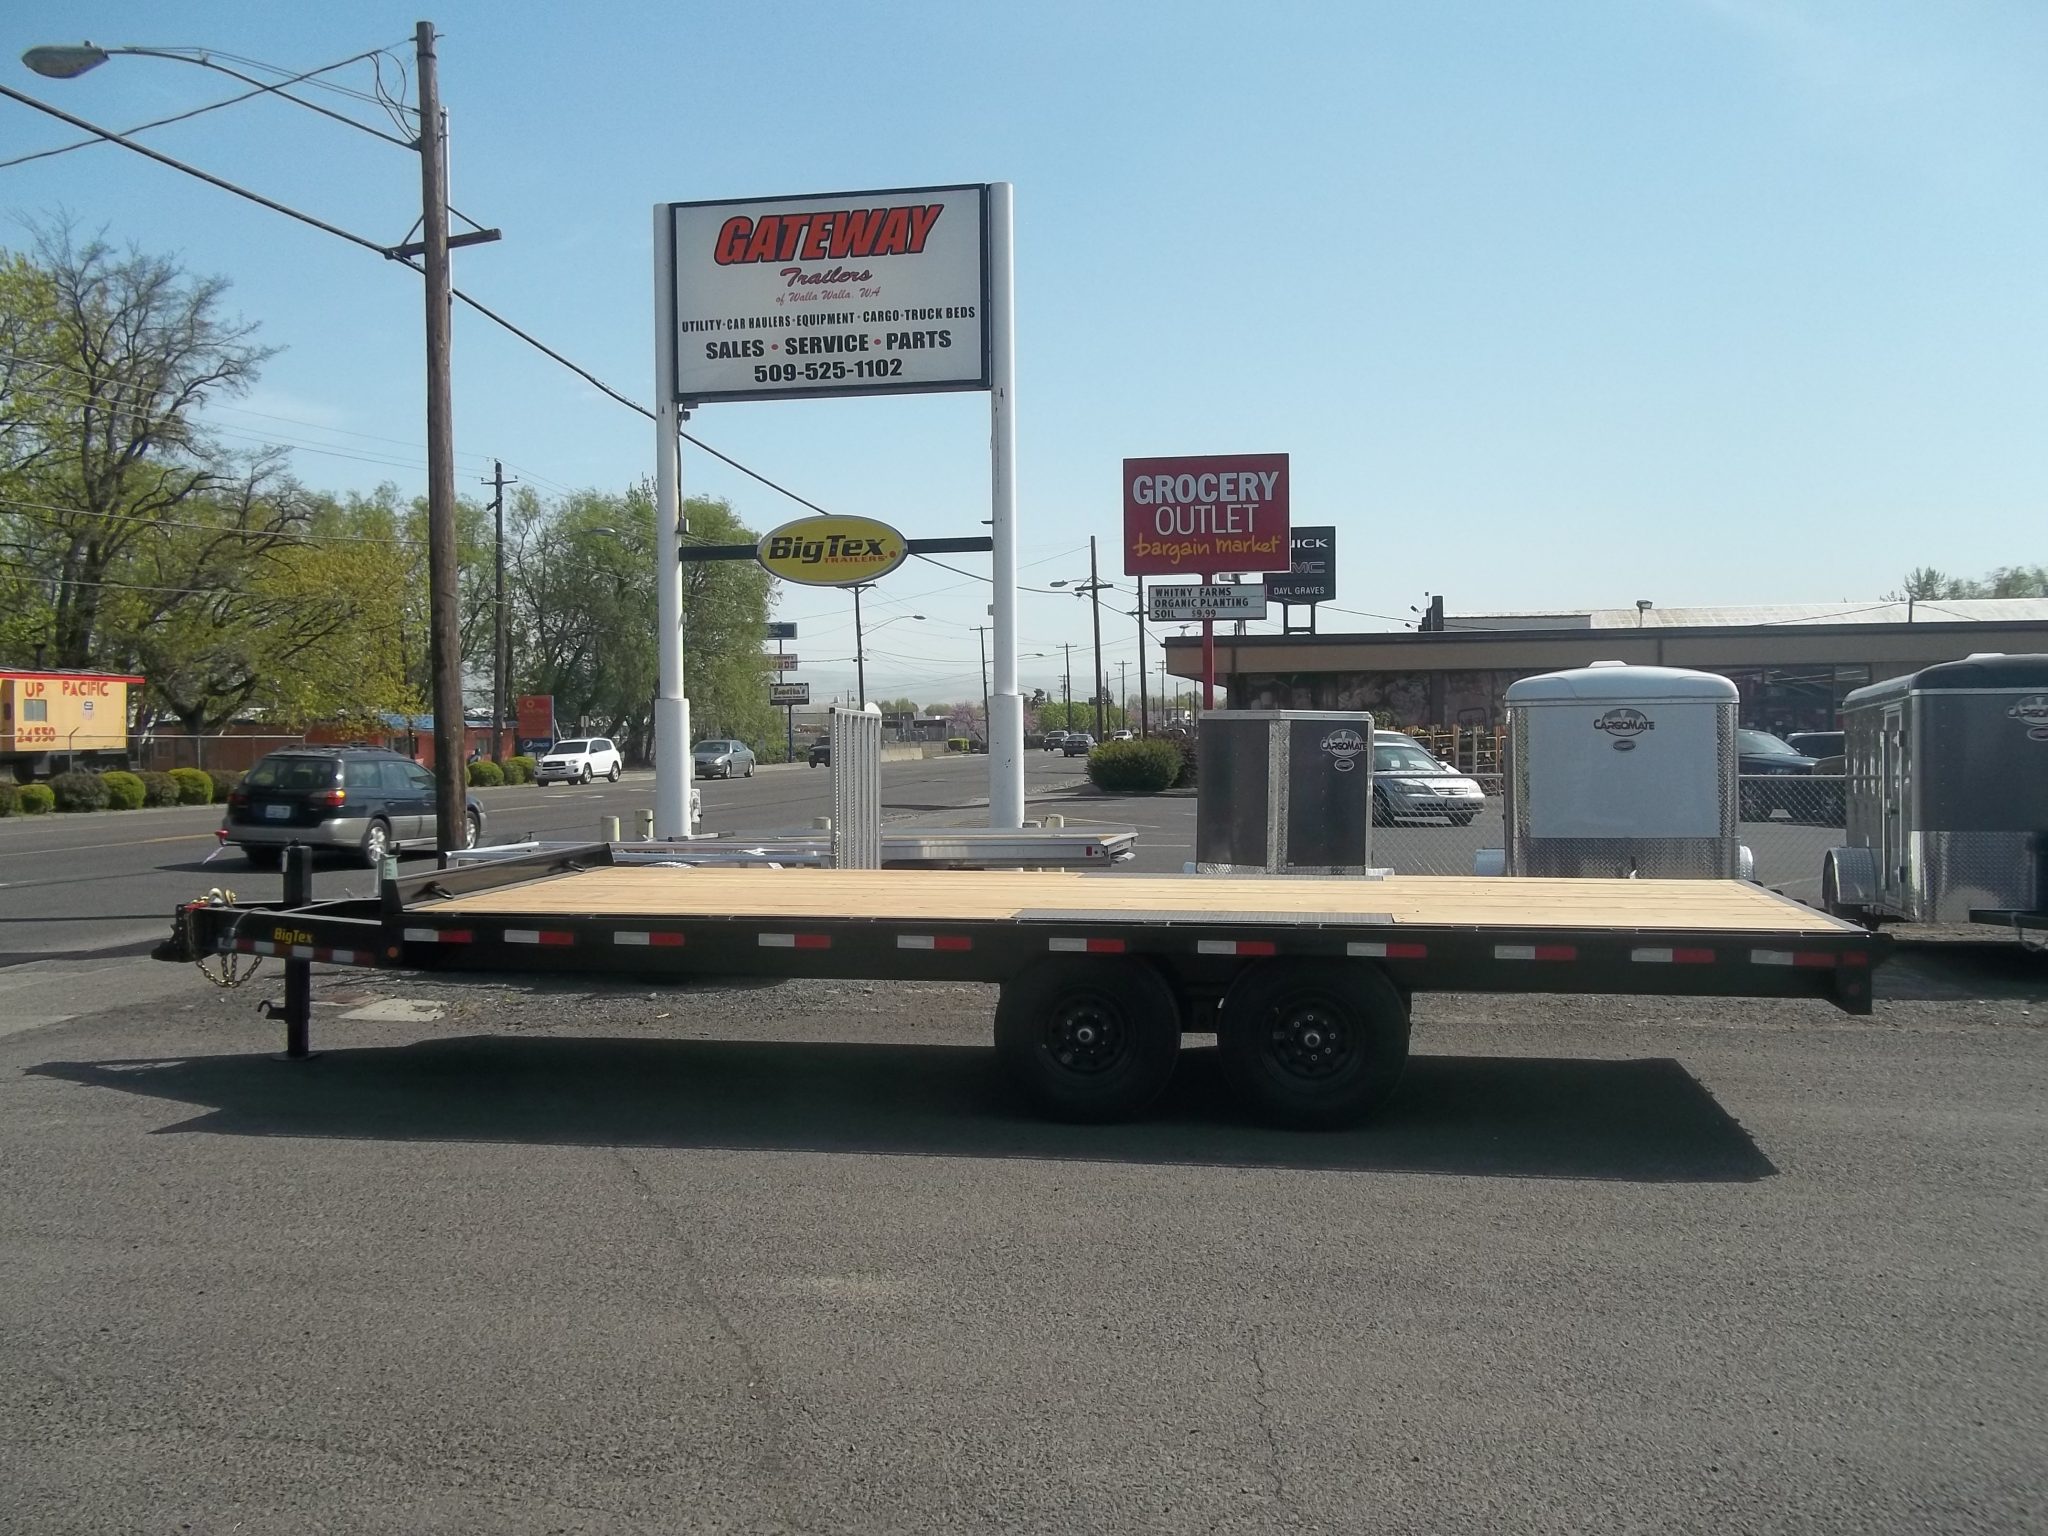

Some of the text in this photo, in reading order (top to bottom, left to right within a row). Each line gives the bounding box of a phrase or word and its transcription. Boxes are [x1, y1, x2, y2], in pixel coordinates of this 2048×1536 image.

[714, 204, 944, 265] GATEWAY
[780, 266, 873, 287] Trailers
[776, 293, 786, 306] of
[789, 292, 818, 303] Walla
[859, 286, 881, 298] WA
[682, 306, 976, 332] UTILITY CAR HAULERS EQUIPMENT CARGO TRUCK BEDS
[706, 329, 952, 360] SALES SERVICE PARTS
[754, 358, 903, 383] 509-525-1102
[1132, 471, 1279, 505] GROCERY
[1155, 504, 1260, 535] OUTLET
[769, 535, 886, 564] BigTex
[1133, 532, 1281, 565] bargain market
[824, 555, 888, 563] TRAILERS
[1155, 587, 1231, 597] WHITNY FARMS
[1273, 586, 1325, 595] DAYL GRAVES
[1154, 598, 1249, 608] ORGANIC PLANTING
[1154, 609, 1216, 618] SOIL $9.99
[25, 681, 109, 697] UP PACIFIC
[16, 727, 56, 743] 24550
[274, 927, 313, 945] BigTex
